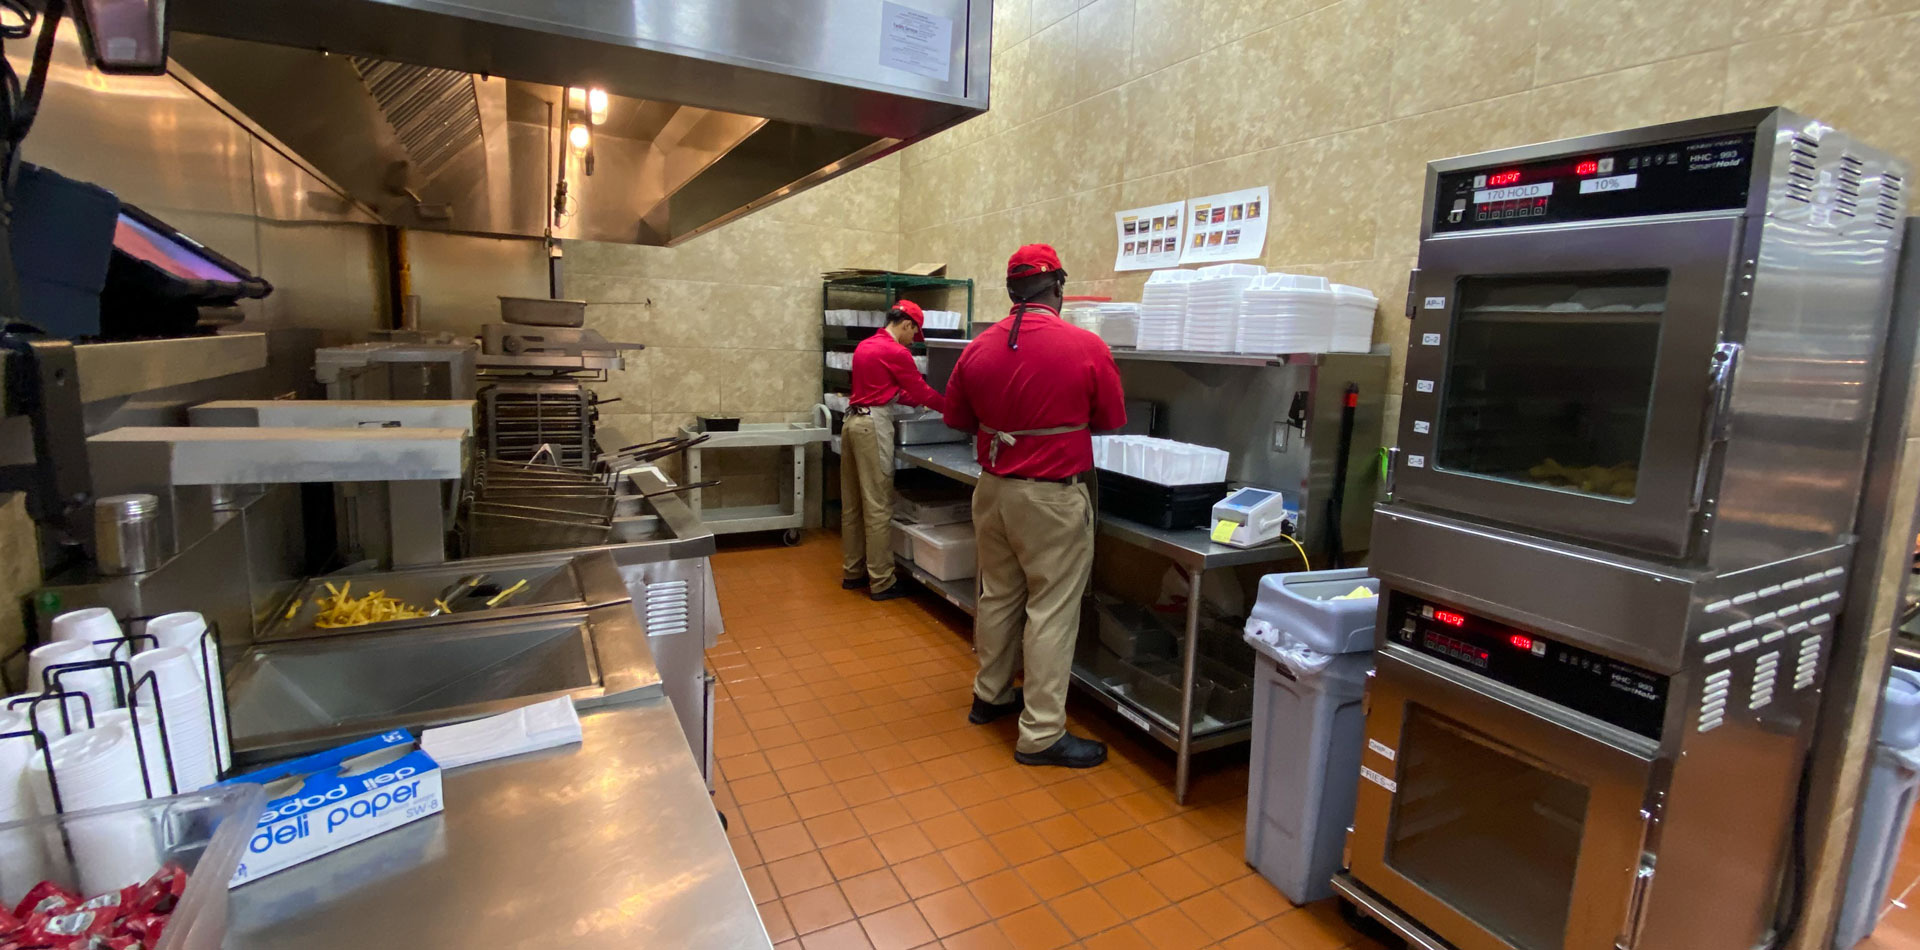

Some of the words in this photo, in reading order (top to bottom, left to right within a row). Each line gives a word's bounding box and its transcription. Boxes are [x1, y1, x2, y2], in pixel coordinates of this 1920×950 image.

[1487, 190, 1505, 200] 170
[1507, 186, 1540, 198] HOLD
[1595, 178, 1620, 190] 10%
[1417, 382, 1432, 390] C-3
[362, 766, 416, 791] deli
[259, 784, 348, 823] pape
[249, 814, 310, 854] deli
[327, 780, 421, 834] paper
